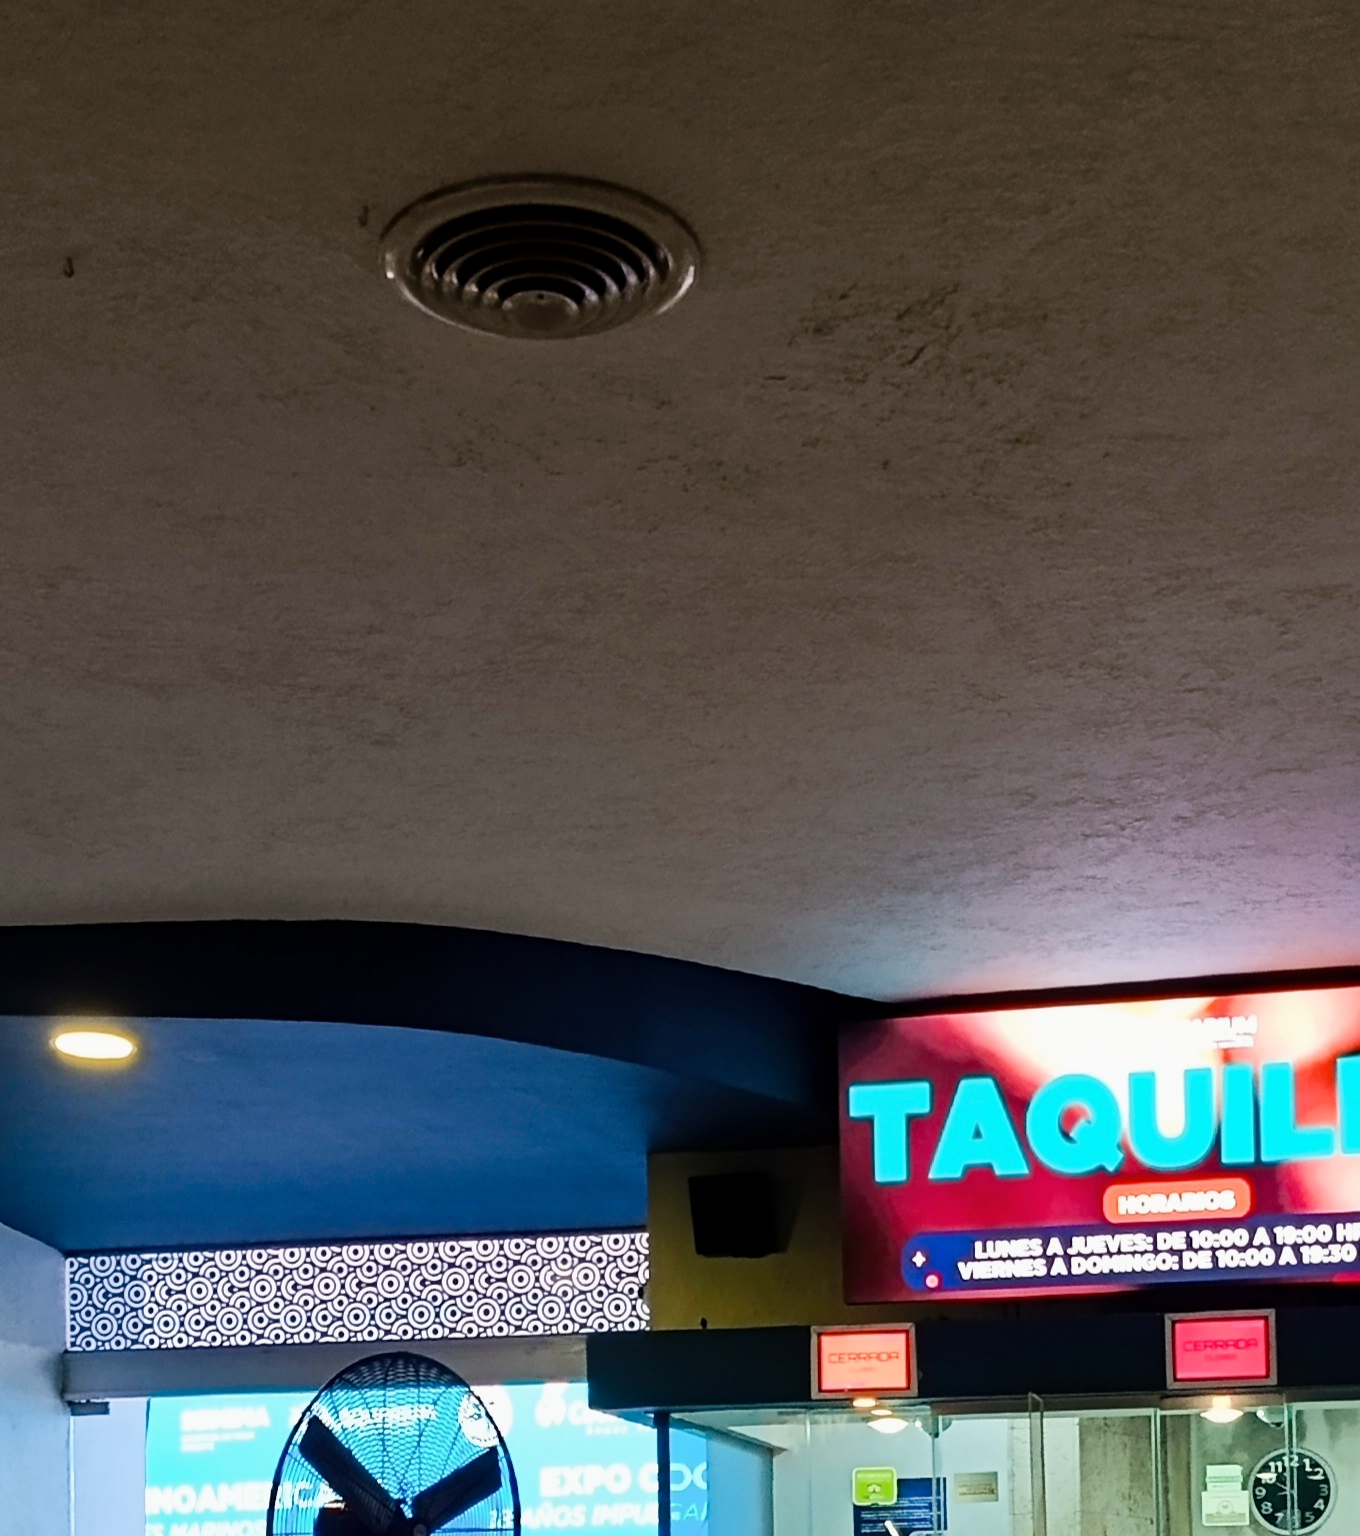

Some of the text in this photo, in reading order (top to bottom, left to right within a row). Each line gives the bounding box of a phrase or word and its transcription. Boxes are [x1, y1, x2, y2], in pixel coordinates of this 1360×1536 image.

[1117, 1189, 1237, 1215] HORARIOS
[974, 1238, 1043, 1260] LUNES
[1046, 1237, 1065, 1256] A
[1067, 1233, 1154, 1256] JUEVES:
[1156, 1231, 1187, 1251] DE
[1189, 1228, 1249, 1249] 10:00
[1252, 1226, 1271, 1246] A
[957, 1258, 1047, 1281] VIERNES
[1050, 1257, 1069, 1277] A
[1071, 1253, 1180, 1276] DOMINGO:
[1182, 1249, 1214, 1271] DE
[1215, 1247, 1276, 1269] 10:00
[1278, 1246, 1298, 1266] A
[1183, 1338, 1258, 1351] CERRADA
[828, 1352, 899, 1364] CERRADA
[1269, 1461, 1283, 1473] 11
[1303, 1458, 1313, 1472] 1
[540, 1464, 633, 1496] EXPO
[1255, 1487, 1266, 1499] 9
[1319, 1484, 1329, 1496] 3
[1261, 1501, 1273, 1514] 8
[1313, 1499, 1325, 1511] 4
[520, 1501, 587, 1529] AÑOS
[1305, 1512, 1315, 1523] 5
